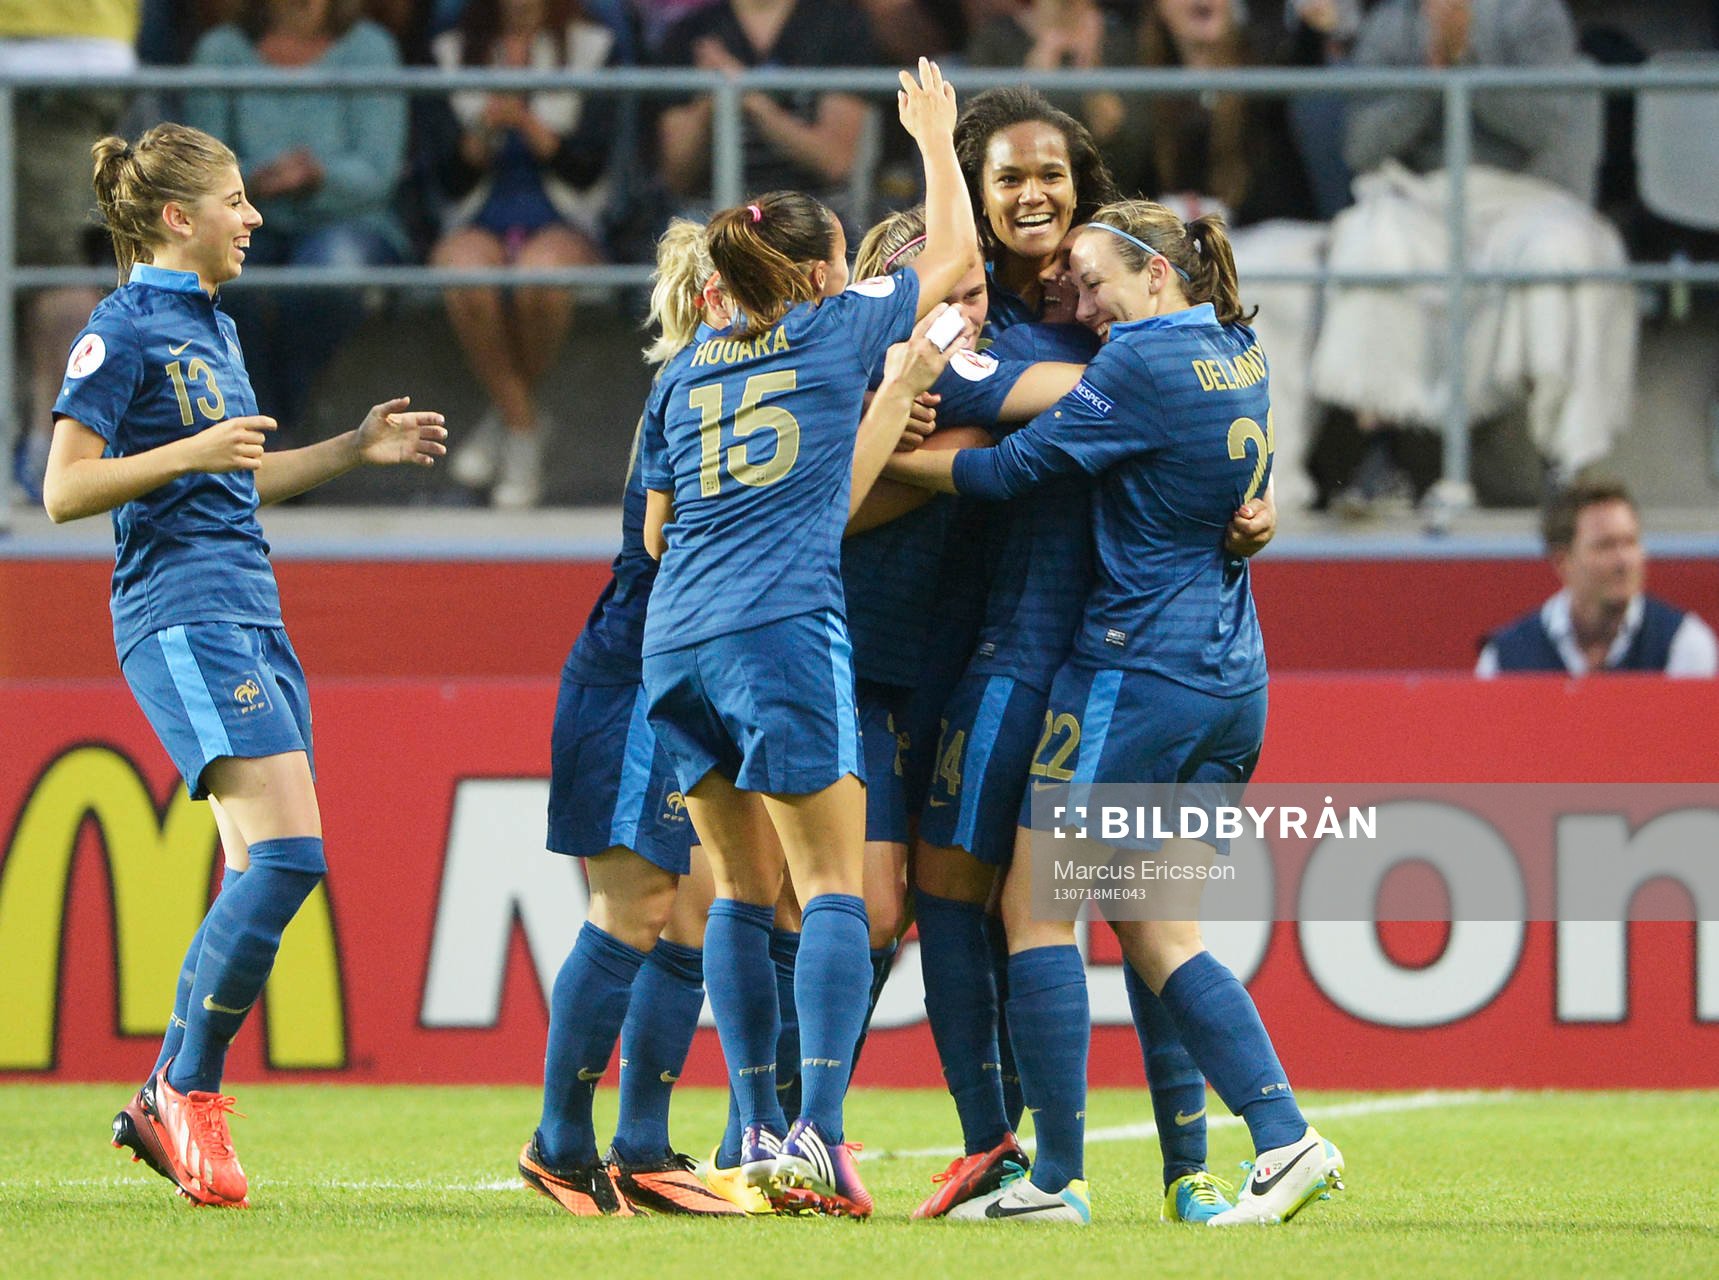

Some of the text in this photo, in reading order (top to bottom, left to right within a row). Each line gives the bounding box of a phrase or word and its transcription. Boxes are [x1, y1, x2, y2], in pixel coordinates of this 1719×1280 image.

[690, 324, 791, 368] HOUARA
[165, 358, 226, 426] 13
[688, 369, 800, 498] 15
[1029, 709, 1082, 781] 22
[802, 1058, 842, 1068] FFF
